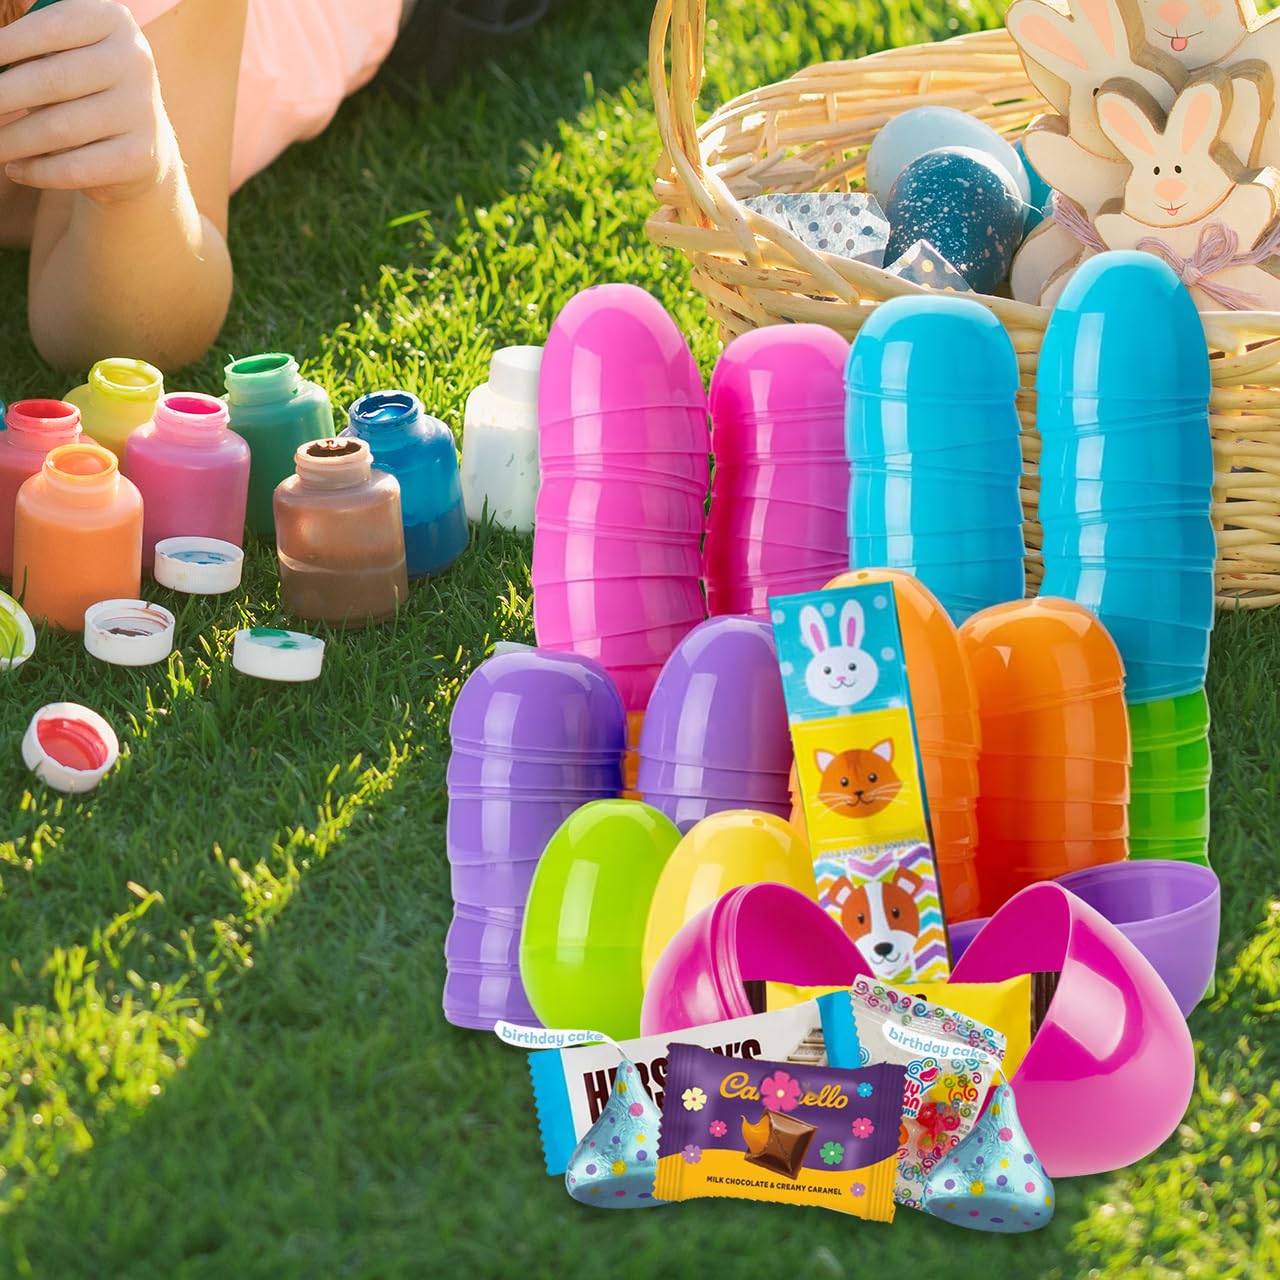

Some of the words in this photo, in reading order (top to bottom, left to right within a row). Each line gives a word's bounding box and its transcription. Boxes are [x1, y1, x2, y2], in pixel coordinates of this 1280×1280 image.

[502, 1026, 564, 1046] birthday
[567, 1031, 604, 1042] cake
[888, 1027, 950, 1058] birthday
[952, 1045, 988, 1060] cake
[720, 1071, 849, 1109] Caello
[706, 1175, 724, 1184] MILK
[725, 1177, 769, 1189] CHOCOLATE
[776, 1182, 807, 1193] CREAMY
[808, 1185, 843, 1196] CARAMEL
